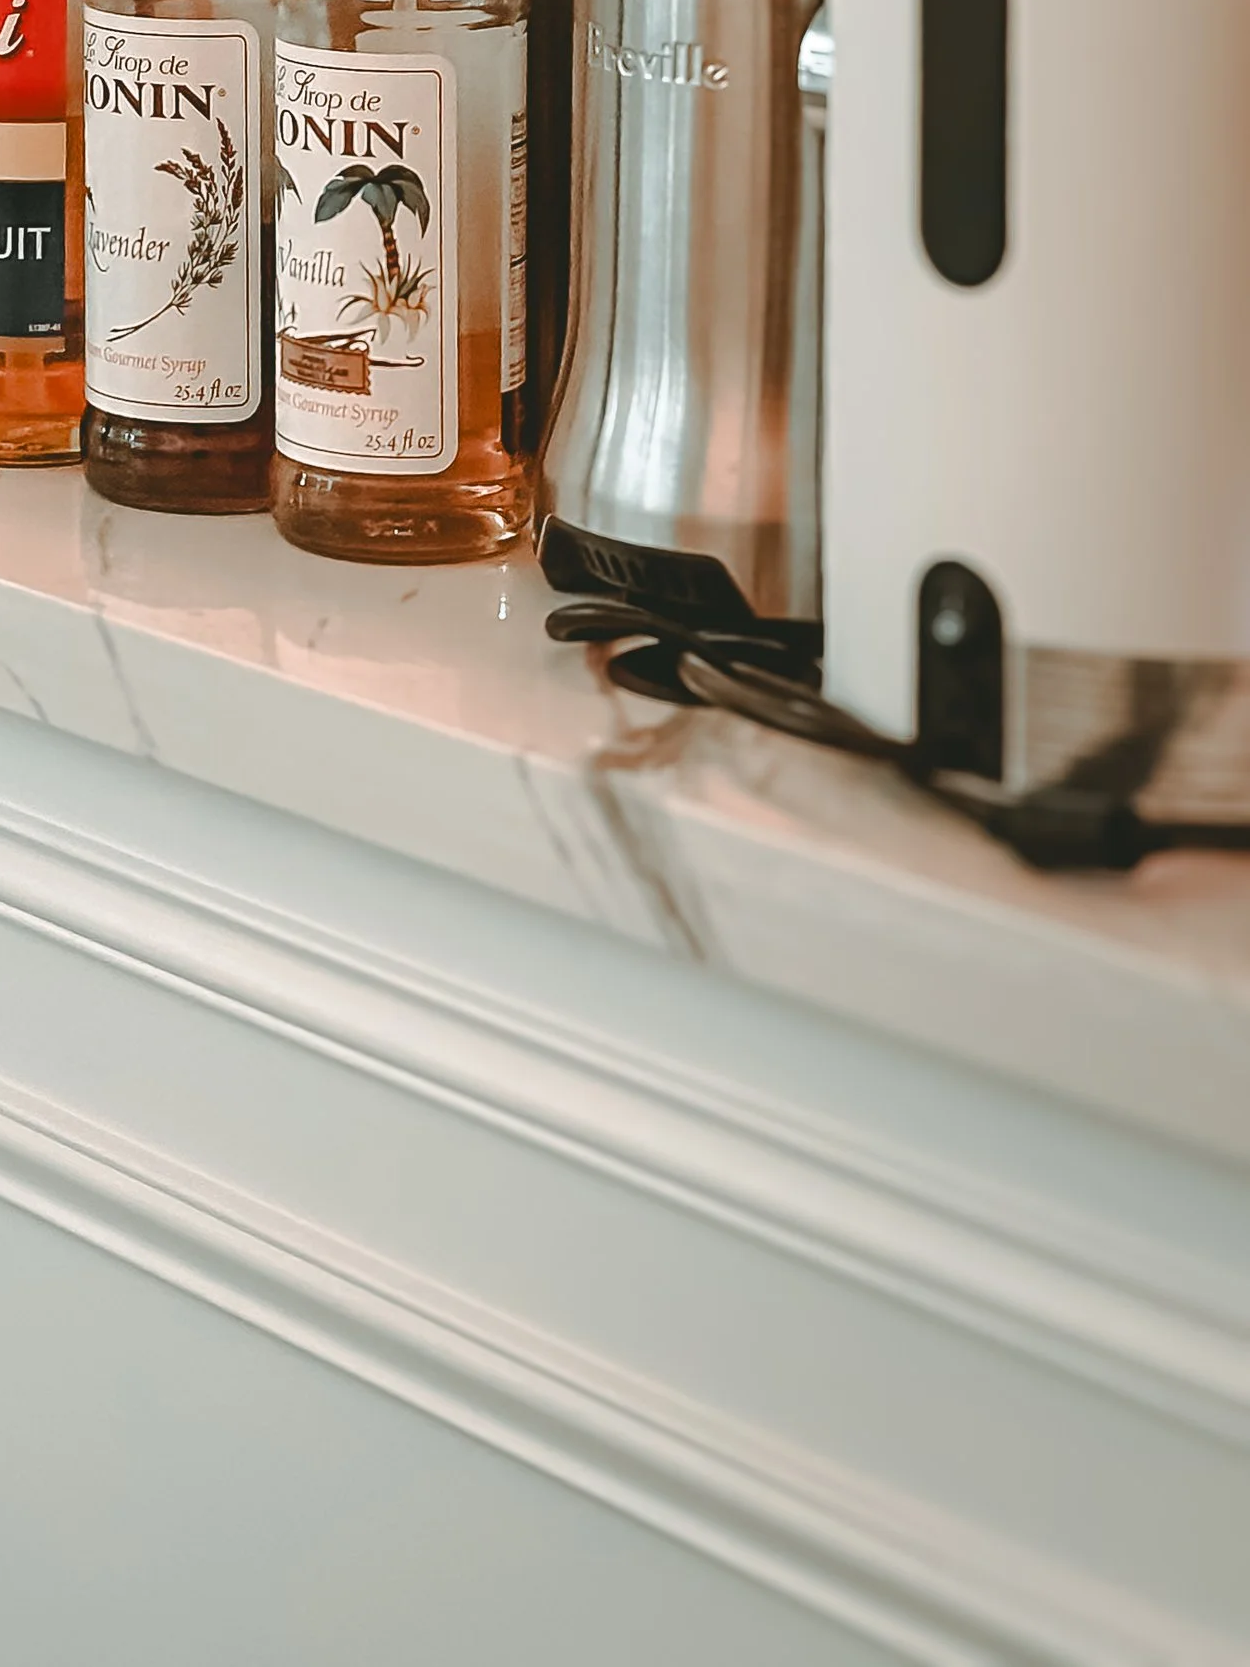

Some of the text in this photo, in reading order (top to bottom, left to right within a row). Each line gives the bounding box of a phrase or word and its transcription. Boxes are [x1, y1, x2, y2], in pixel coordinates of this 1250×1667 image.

[98, 35, 152, 81] Sirop
[159, 55, 189, 75] de
[587, 22, 730, 90] Breville
[288, 69, 343, 117] Sirop
[350, 90, 382, 112] de
[276, 104, 410, 160] ONIN
[278, 238, 345, 287] Vanilla
[103, 346, 156, 371] Gourmet
[161, 355, 207, 381] Syrup
[174, 377, 243, 406] 25.4 fl oz
[292, 392, 348, 419] Gourmet
[351, 403, 400, 430] Syrup
[365, 428, 436, 456] 25.4 fl oz
